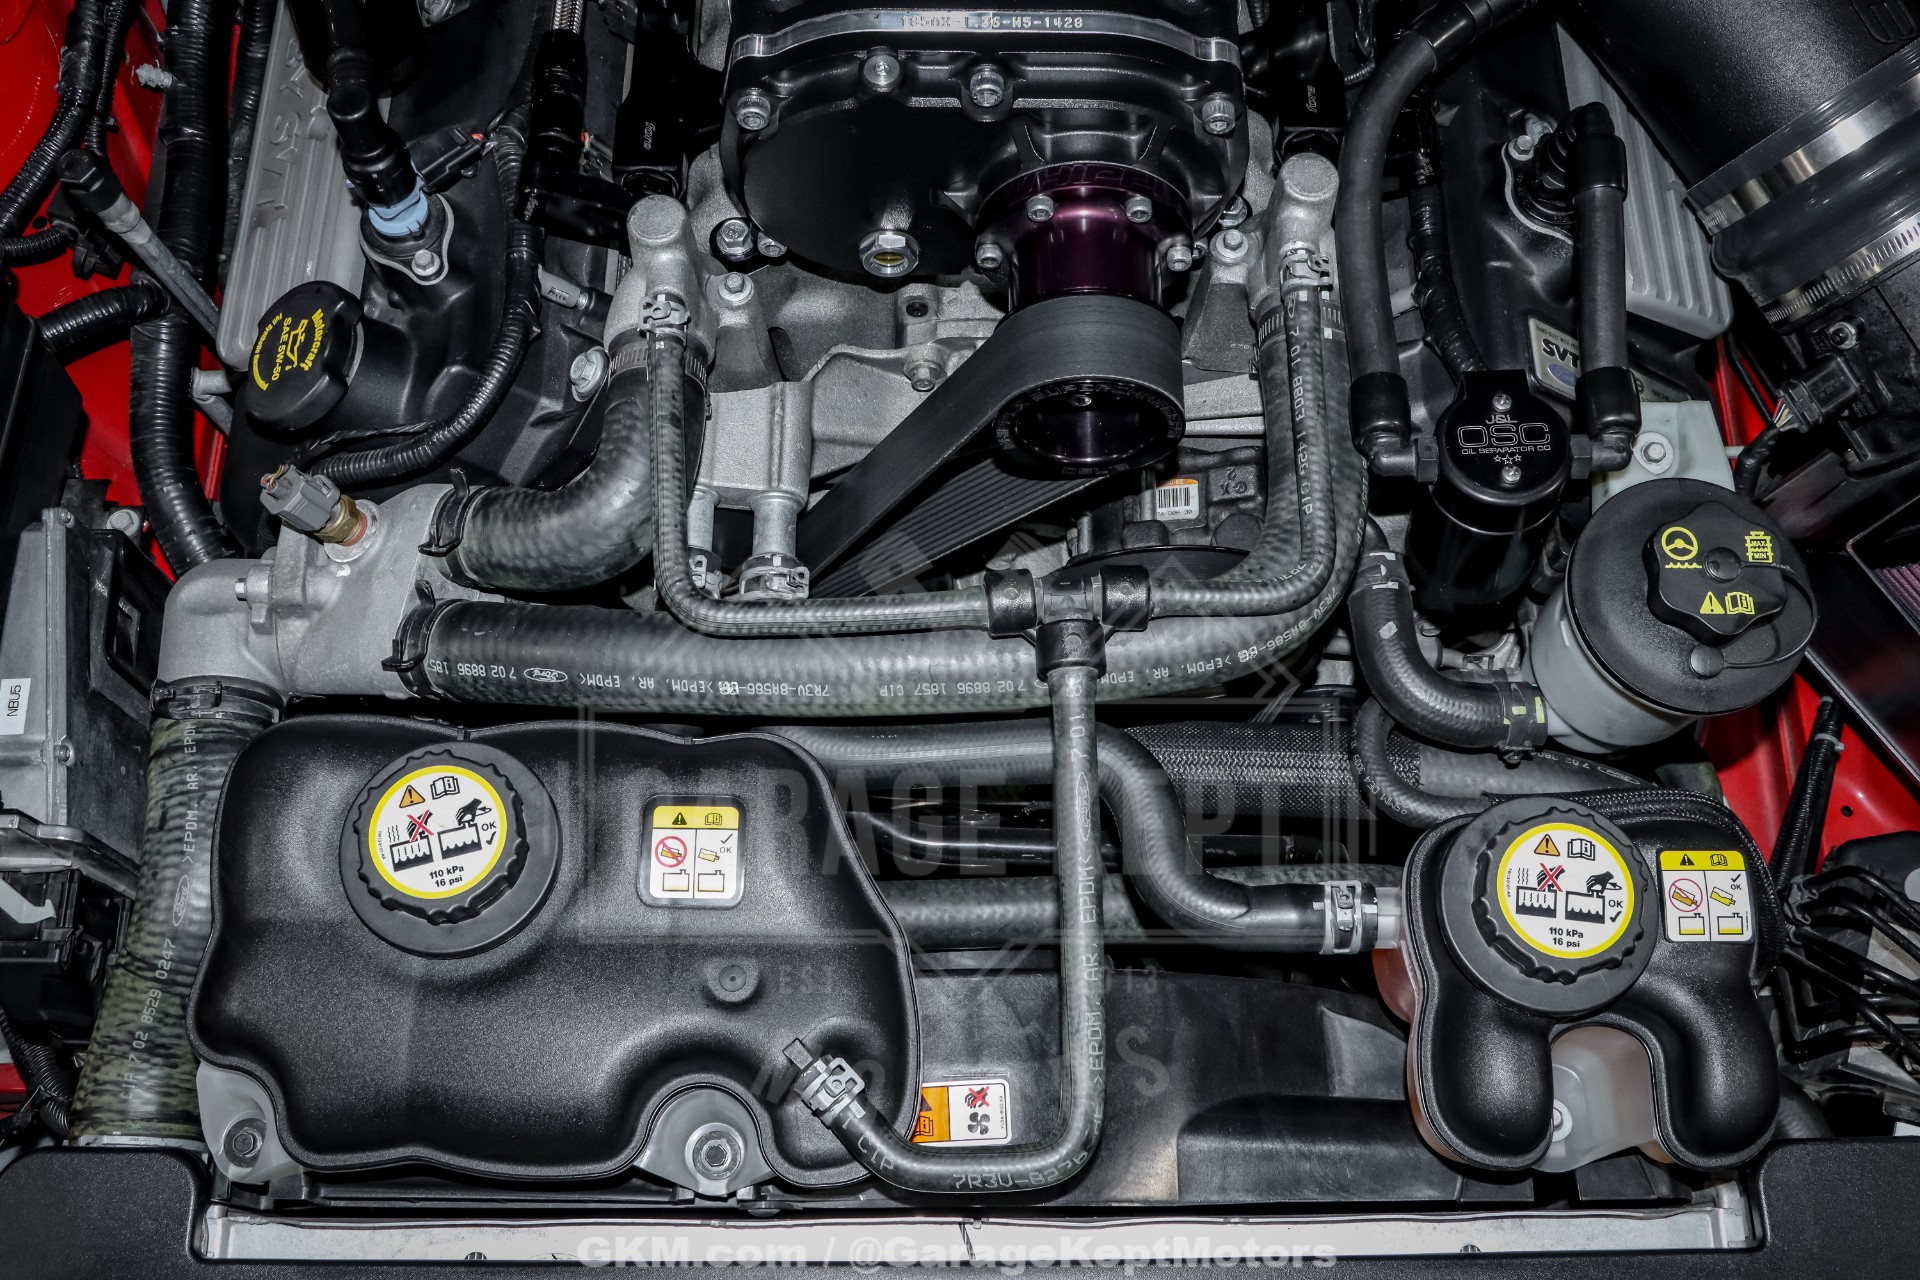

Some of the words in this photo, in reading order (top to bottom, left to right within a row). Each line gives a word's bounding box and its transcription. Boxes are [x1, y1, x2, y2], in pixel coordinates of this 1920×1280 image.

[280, 316, 292, 343] SAE
[300, 308, 325, 371] Motorcraft
[1542, 338, 1580, 369] SVT
[272, 344, 286, 381] 5W-50
[1485, 414, 1517, 425] J&L
[1457, 422, 1551, 448] OSC
[1478, 446, 1535, 455] SEPARATOR
[1536, 444, 1551, 452] CO
[457, 662, 486, 677] 8896
[491, 664, 506, 679] 02
[509, 666, 516, 679] 7
[527, 668, 564, 682] Ford
[631, 676, 654, 689] AR,
[914, 683, 946, 695] 1857
[957, 681, 991, 694] 8896
[997, 680, 1015, 692] 02
[1017, 680, 1026, 691] 7
[6, 684, 22, 717] NBU5
[481, 821, 497, 832] OK
[719, 846, 732, 854] OK
[429, 869, 443, 880] 110
[446, 865, 465, 876] kPa
[434, 878, 446, 888] 16
[448, 875, 463, 887] psi
[1608, 899, 1624, 909] OK
[1548, 926, 1564, 936] 110
[1566, 928, 1584, 939] kPa
[1552, 937, 1564, 946] 16
[1566, 938, 1580, 948] psi
[155, 938, 176, 980] 0247
[141, 988, 162, 1024] 8529
[132, 1031, 149, 1049] 02
[128, 1053, 142, 1064] 7
